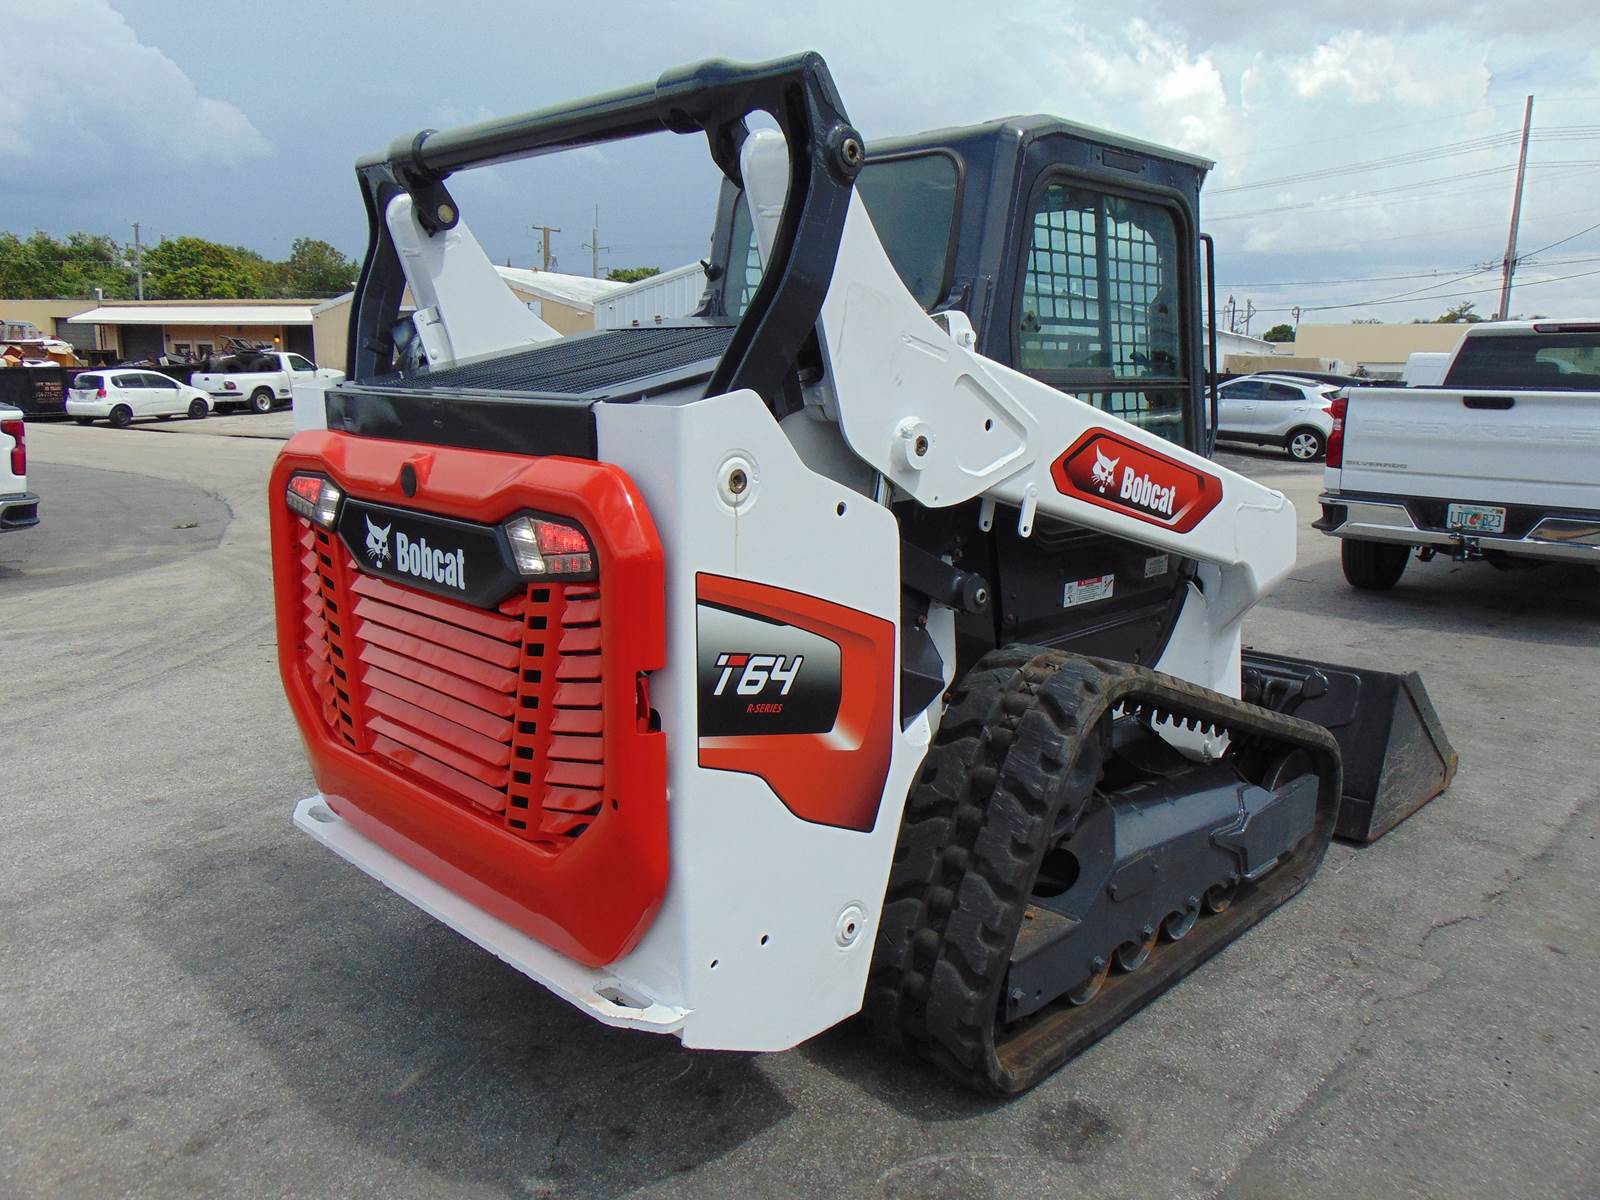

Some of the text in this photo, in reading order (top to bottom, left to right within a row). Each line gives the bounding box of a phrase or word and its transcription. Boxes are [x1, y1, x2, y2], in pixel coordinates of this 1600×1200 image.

[1360, 418, 1600, 443] CHEVROLE
[1345, 460, 1408, 469] SILVERADO
[1120, 465, 1176, 516] Bobcat
[396, 532, 465, 590] Bobcat
[713, 652, 804, 696] T64
[746, 703, 784, 713] R-SERIES
